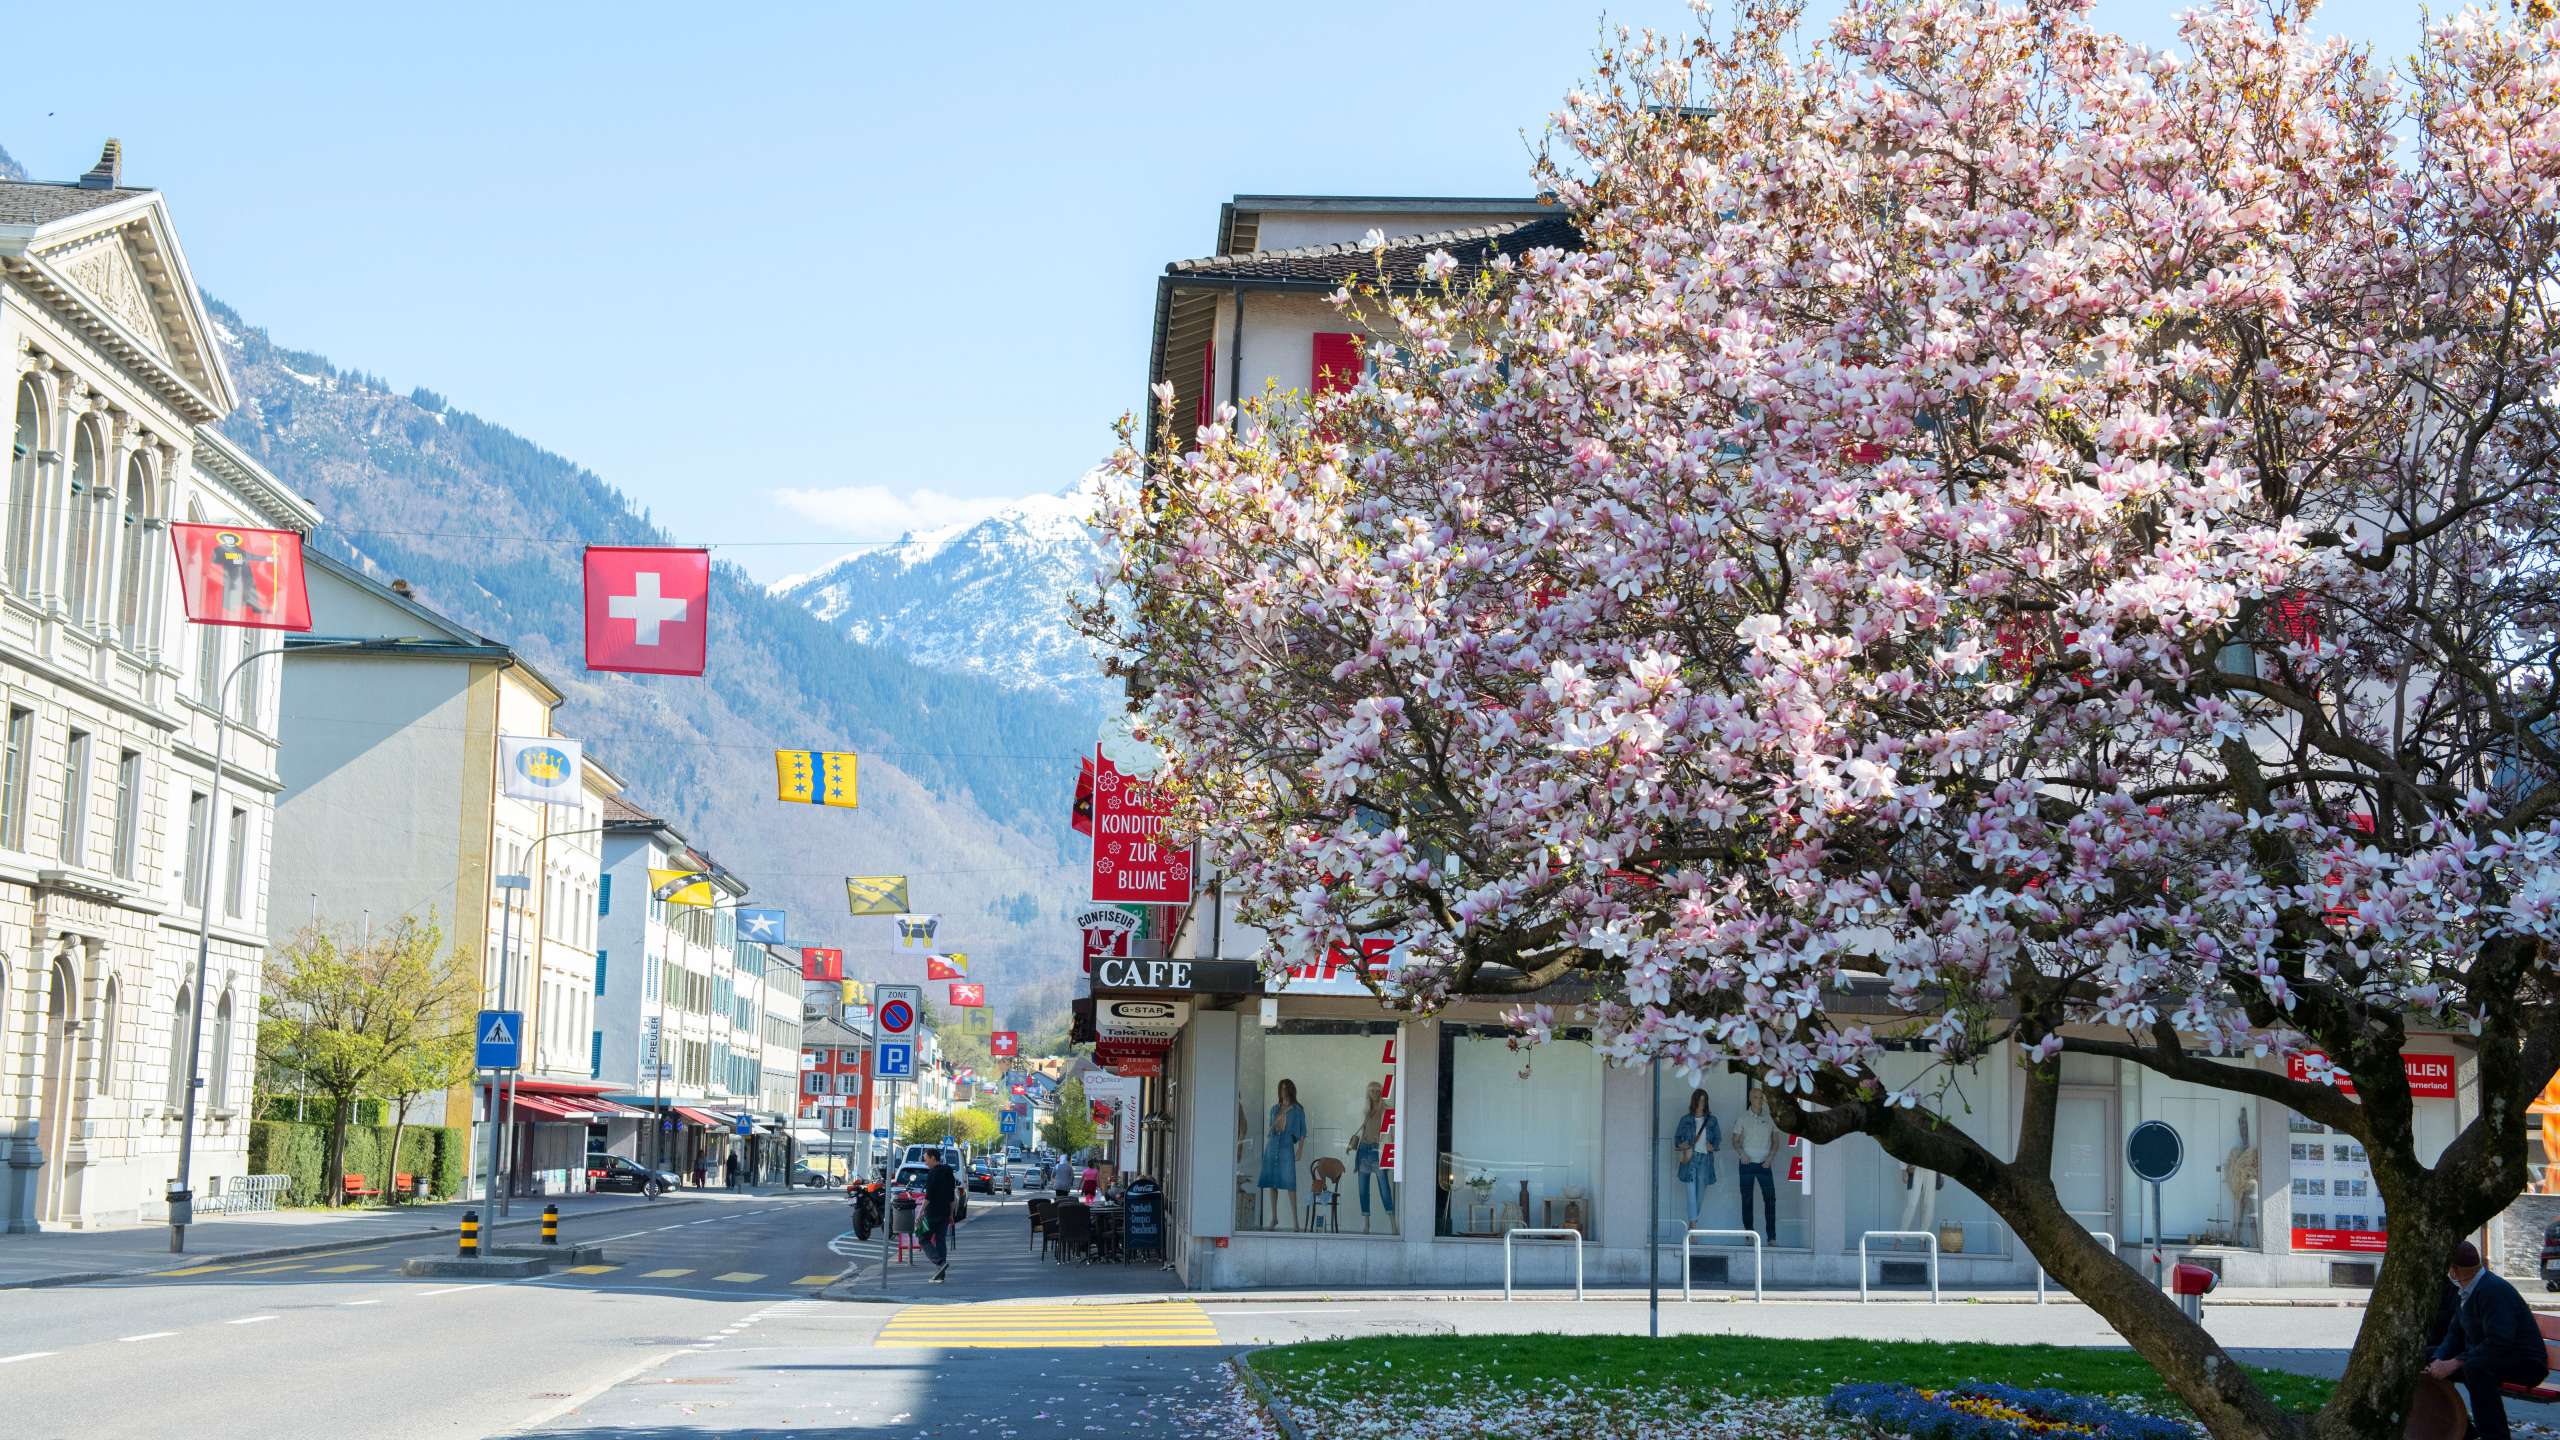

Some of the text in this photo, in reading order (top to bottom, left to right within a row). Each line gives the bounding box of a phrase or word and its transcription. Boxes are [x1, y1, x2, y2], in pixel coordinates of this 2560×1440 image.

[1129, 842, 1157, 862] ZUR
[1118, 870, 1167, 890] BLUME
[1078, 910, 1135, 929] CONFISEUR
[1100, 960, 1192, 988] CAFE
[887, 991, 908, 999] ZONE
[1121, 1006, 1164, 1014] G-STAR
[650, 1017, 659, 1058] FREULER
